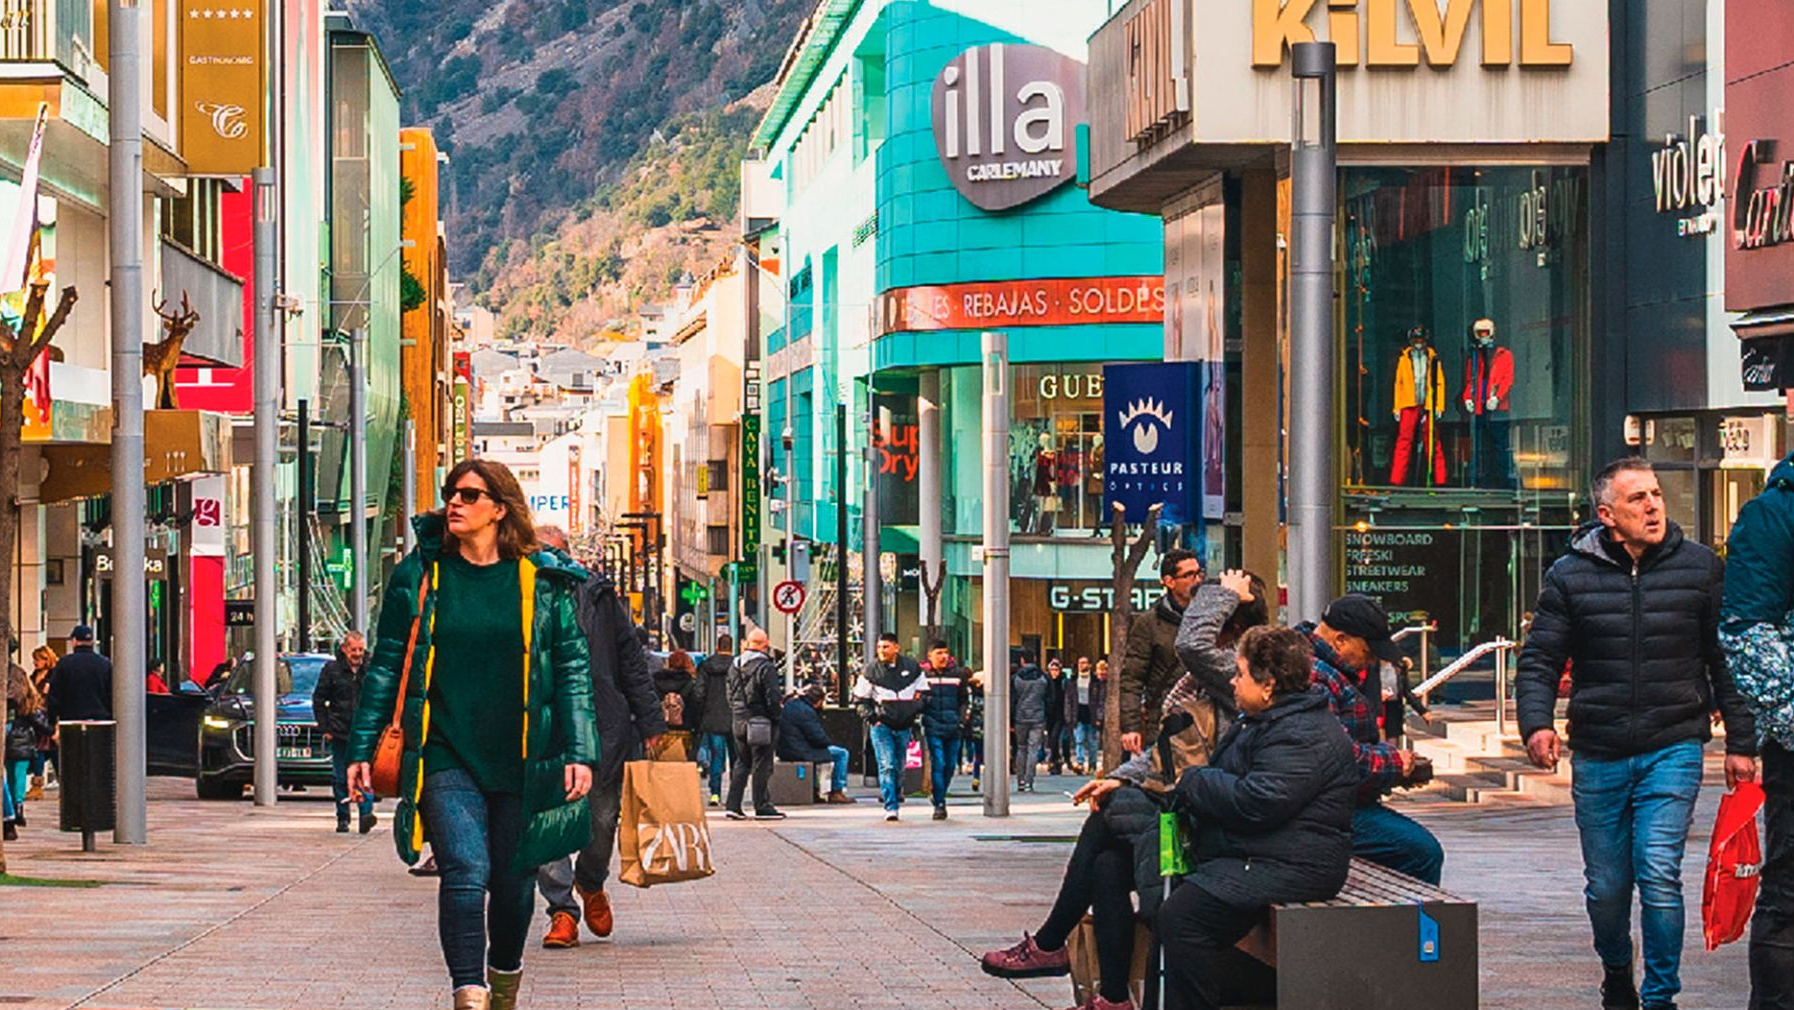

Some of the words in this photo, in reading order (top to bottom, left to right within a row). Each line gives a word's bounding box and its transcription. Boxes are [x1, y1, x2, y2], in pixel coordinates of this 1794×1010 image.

[189, 55, 254, 65] GASTRONOMIC
[944, 42, 1063, 158] illa
[967, 159, 1064, 181] CARLEMANY
[963, 290, 1048, 318] REBAJAS
[745, 419, 757, 468] CAVA
[1110, 462, 1183, 475] PASTEUR
[745, 478, 758, 553] BENITO
[1346, 533, 1433, 545] SNOWBOARD
[1346, 565, 1426, 576] STREETWEAR
[1346, 581, 1409, 592] SNEAKERS
